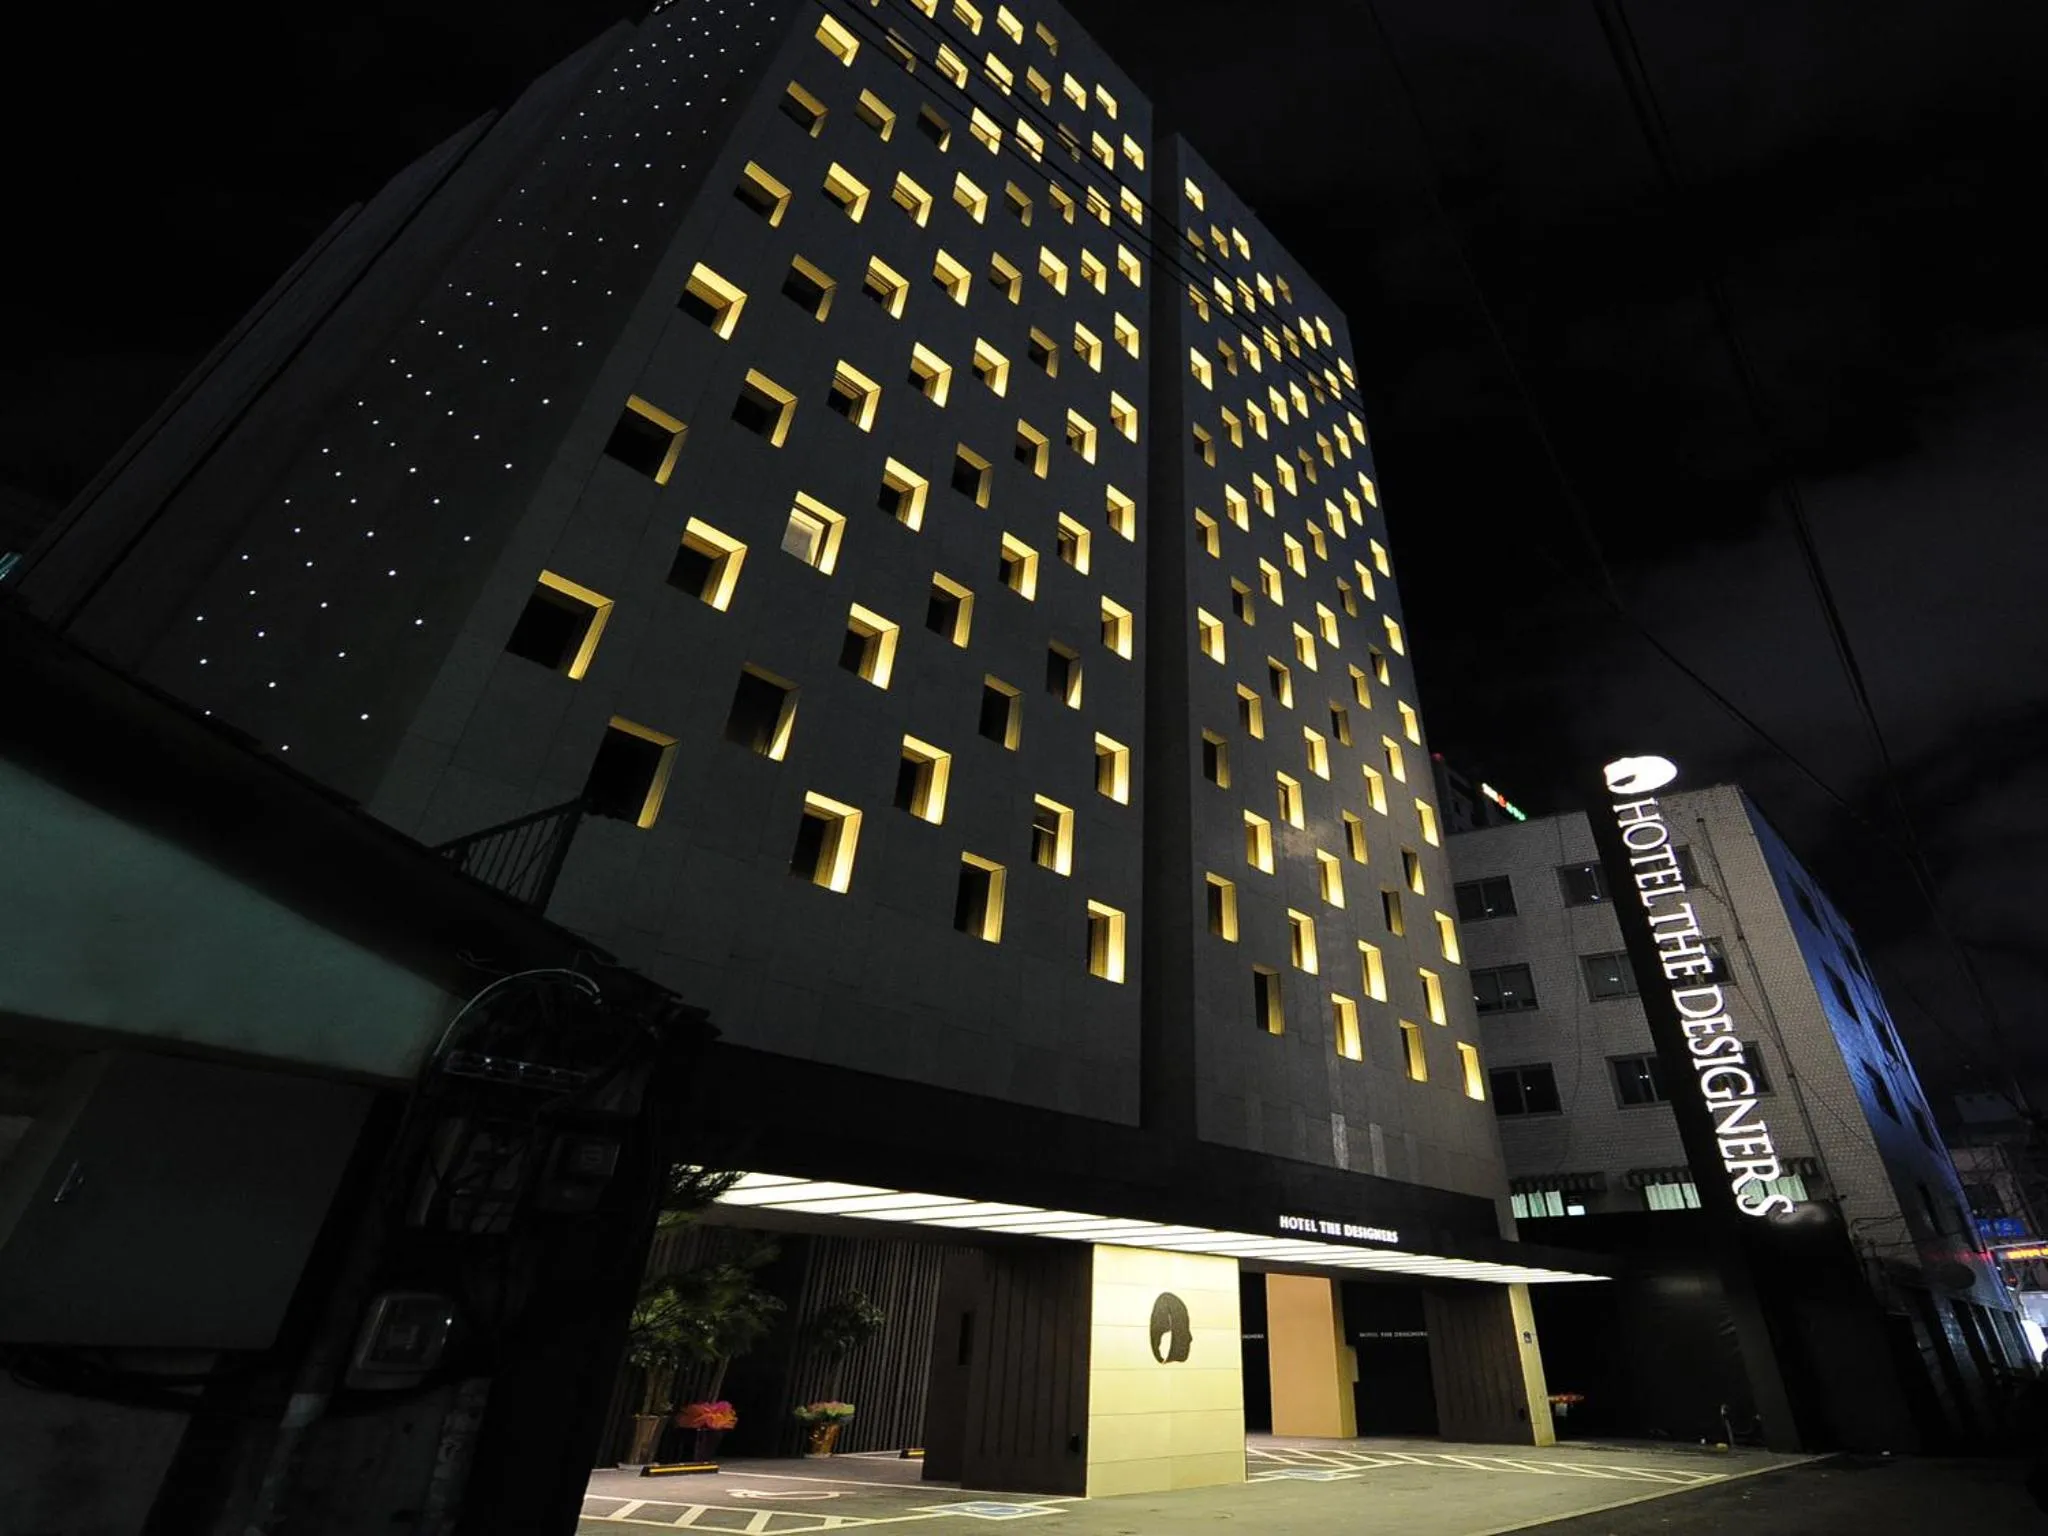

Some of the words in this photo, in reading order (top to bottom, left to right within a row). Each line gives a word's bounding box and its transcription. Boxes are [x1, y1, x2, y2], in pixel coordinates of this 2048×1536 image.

[1613, 797, 1686, 907] HOTEL
[1648, 902, 1714, 980] THE
[1672, 984, 1795, 1217] DESIGNERS
[1279, 1215, 1318, 1233] HOTEL
[1318, 1220, 1342, 1236] THE
[1343, 1223, 1399, 1244] DESIGNERS
